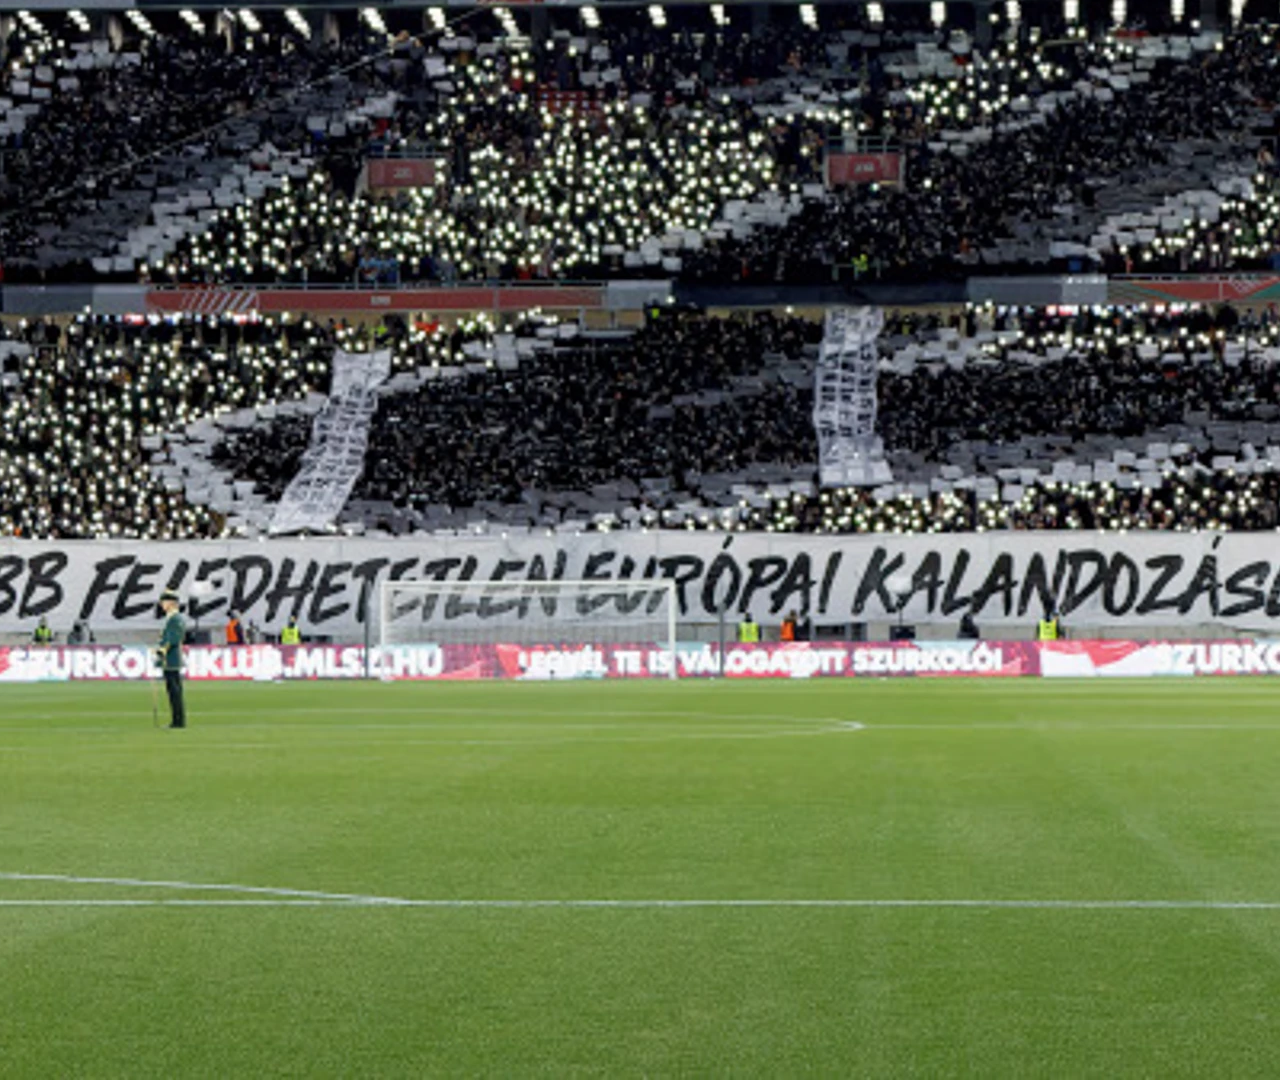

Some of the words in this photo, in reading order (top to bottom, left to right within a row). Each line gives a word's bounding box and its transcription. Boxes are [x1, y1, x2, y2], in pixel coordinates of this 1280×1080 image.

[78, 546, 568, 624] FELEDHETETLEN
[574, 534, 843, 616] EURÓPAI
[10, 646, 441, 677] SZURKOLIKLUB.MLSZ.HU
[614, 650, 641, 674] TE
[649, 650, 673, 674] IS
[677, 644, 847, 674] VÁLOGATOTT
[852, 642, 1003, 672] SZURKOLÓI
